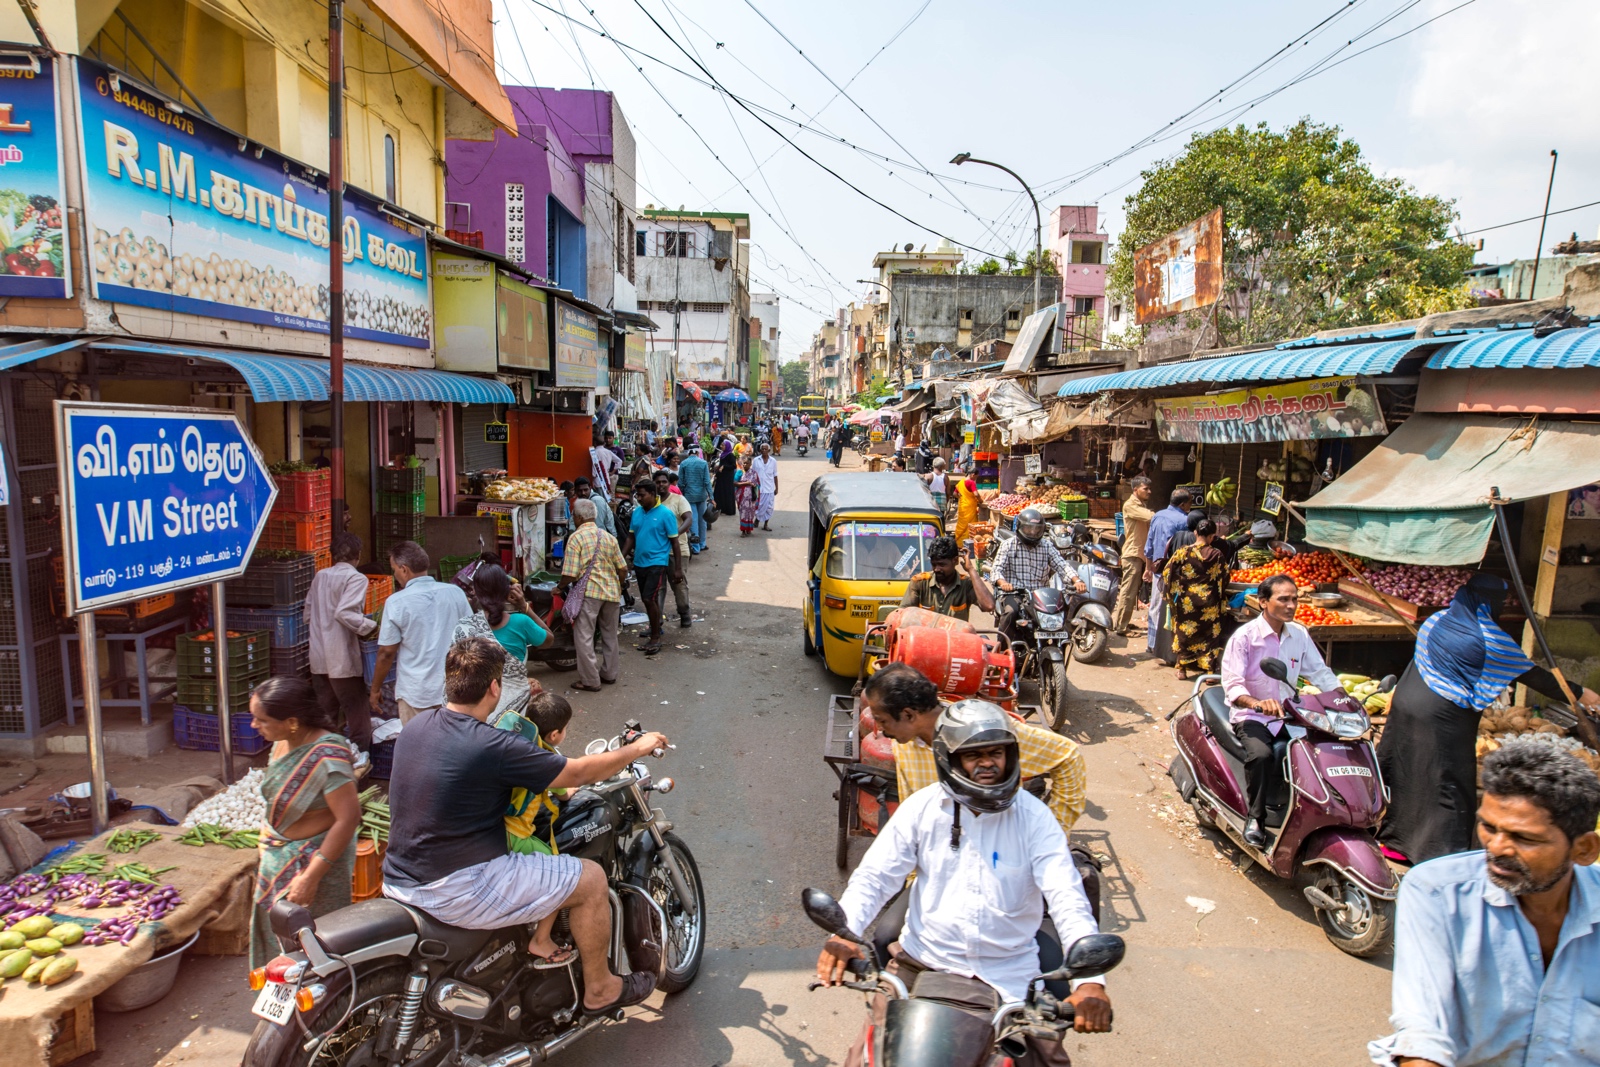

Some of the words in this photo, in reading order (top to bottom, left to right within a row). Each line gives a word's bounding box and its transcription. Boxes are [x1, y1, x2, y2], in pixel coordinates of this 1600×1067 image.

[367, 232, 423, 280] கடை
[77, 424, 175, 478] வி.எம்
[181, 425, 246, 486] தெரு
[96, 499, 154, 547] V.M
[163, 492, 239, 538] Street
[261, 1000, 268, 1012] L
[267, 1002, 285, 1019] 1326
[271, 984, 284, 998] TN
[280, 988, 292, 1002] 06
